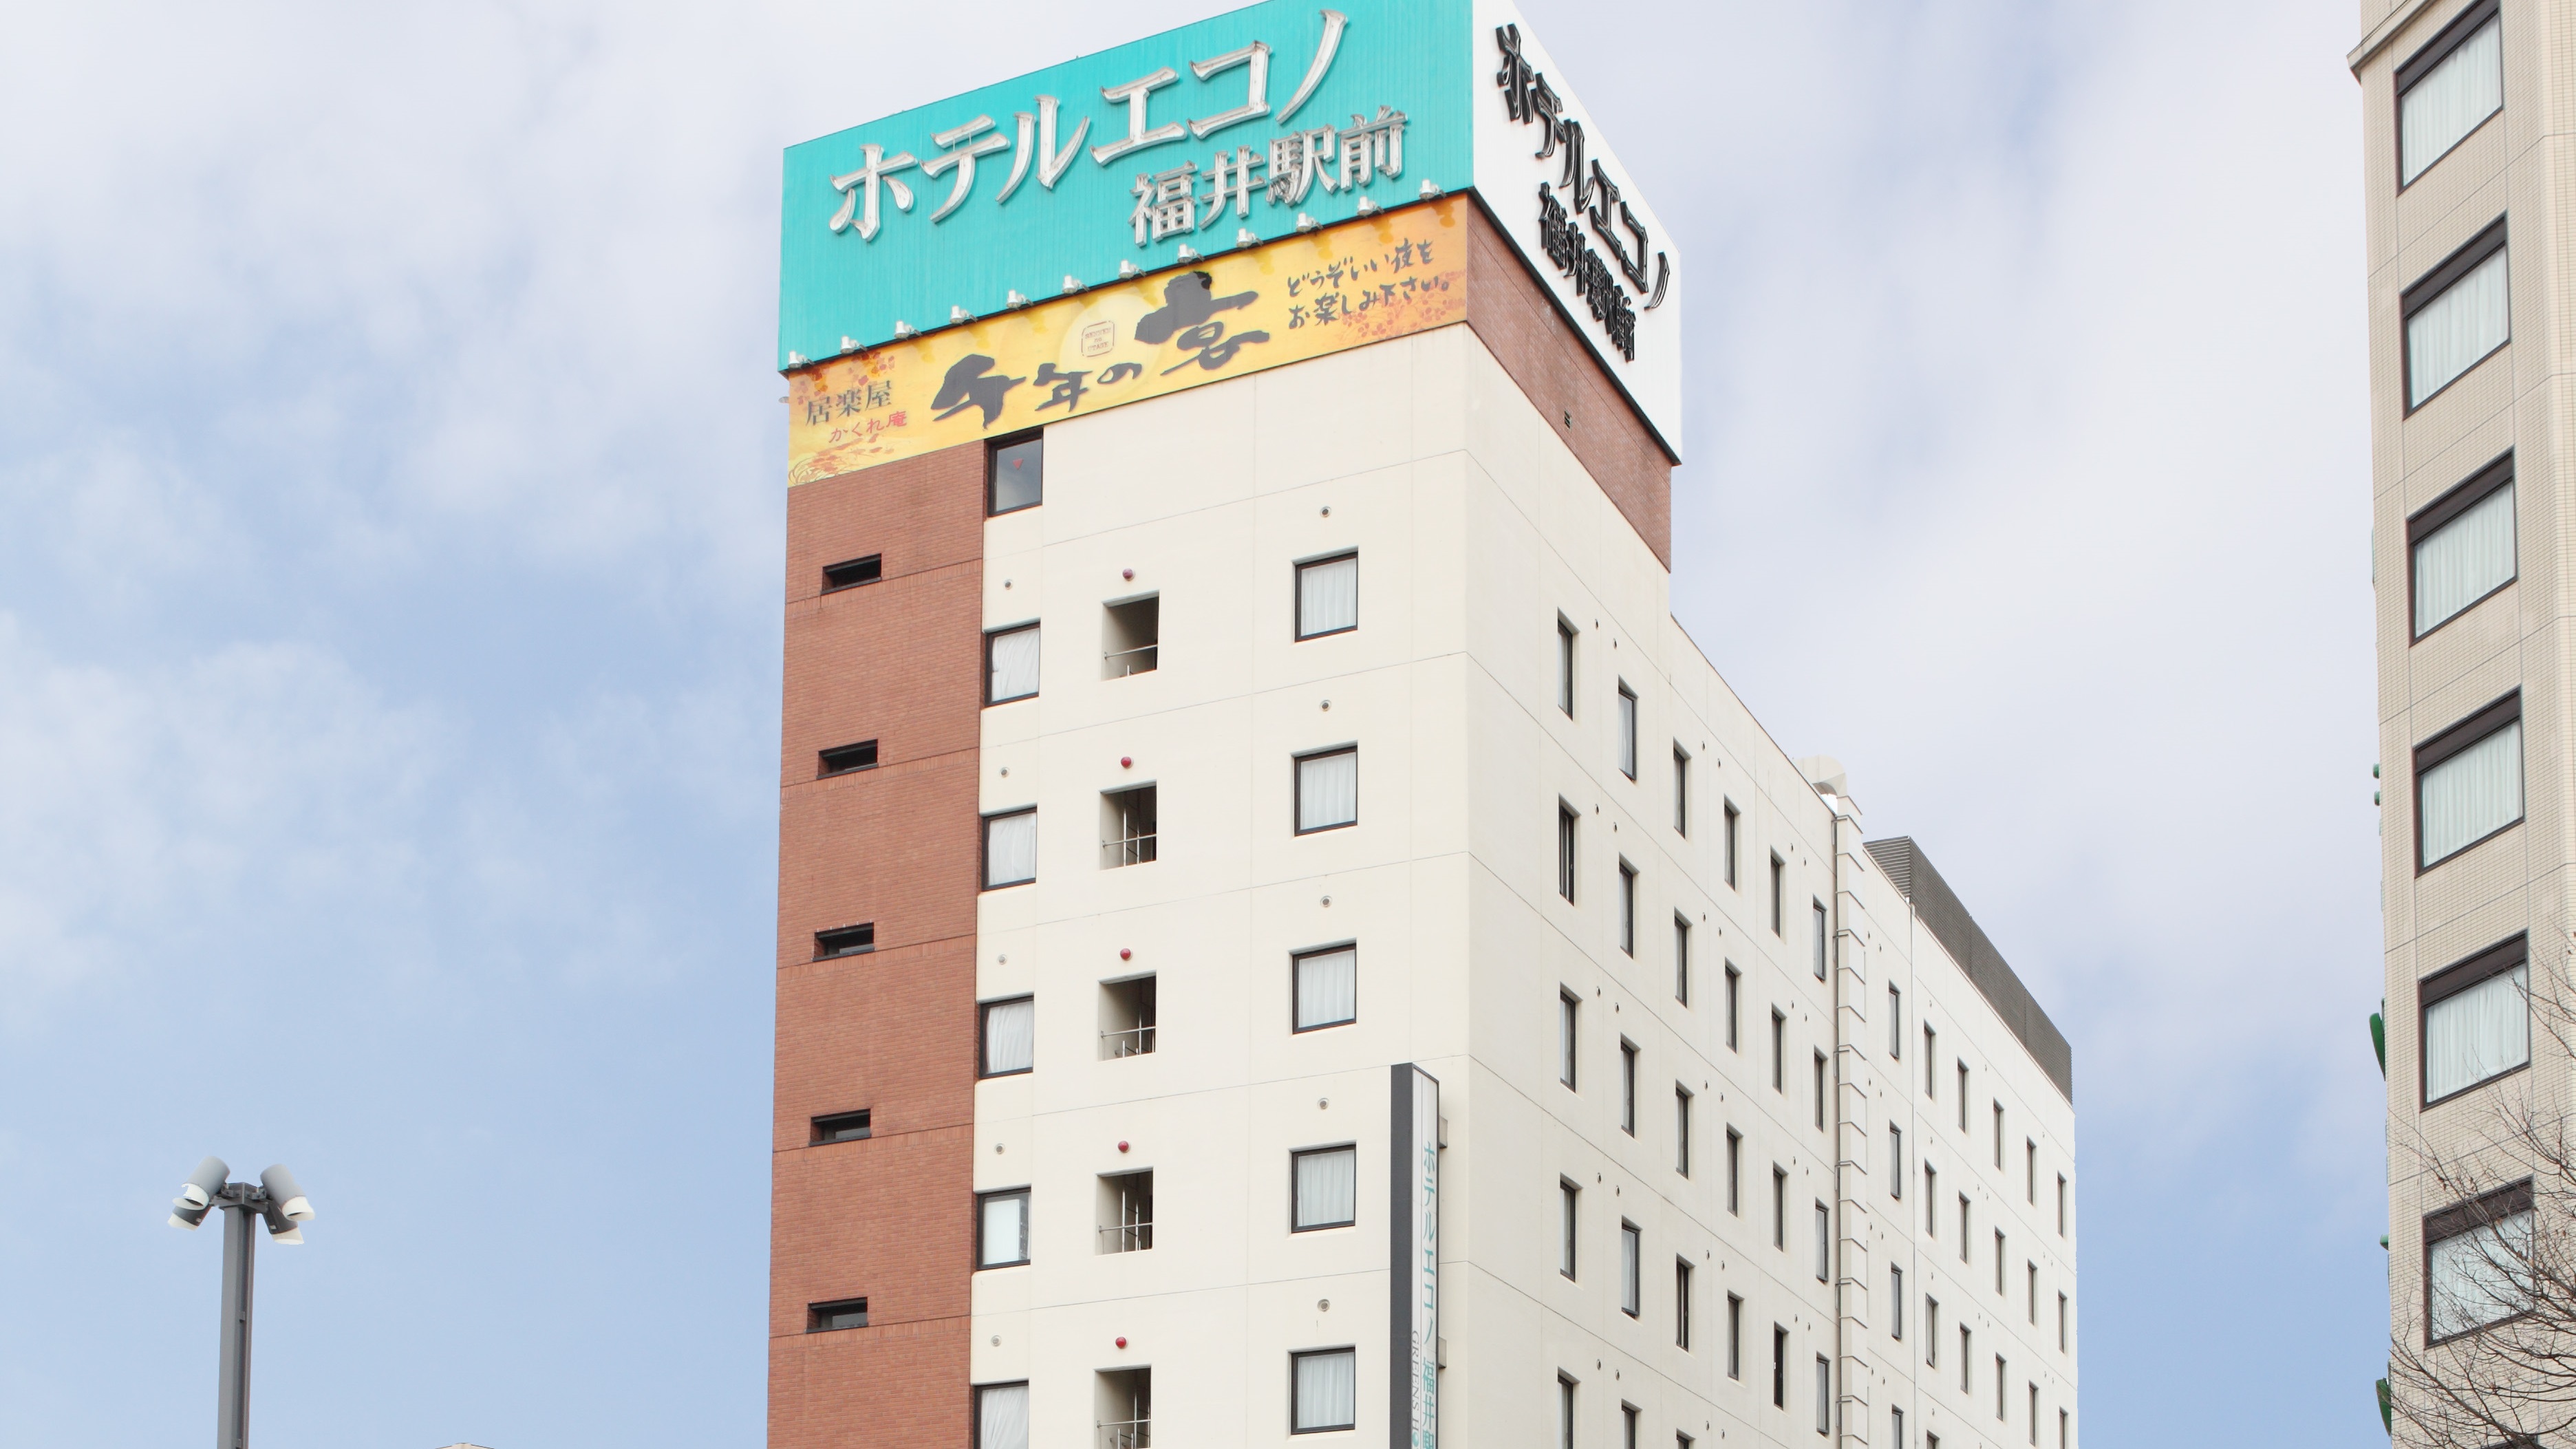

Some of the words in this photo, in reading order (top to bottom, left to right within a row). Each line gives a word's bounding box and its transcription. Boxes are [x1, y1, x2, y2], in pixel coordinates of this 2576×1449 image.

[829, 9, 1348, 242] ホテルエコノ
[1128, 105, 1408, 247] 福井駅前
[1496, 23, 1670, 310] ホテルエコノ
[1287, 237, 1435, 297] どうぞいい夜を
[806, 380, 892, 427] 居楽屋
[828, 410, 908, 444] かくれ庵
